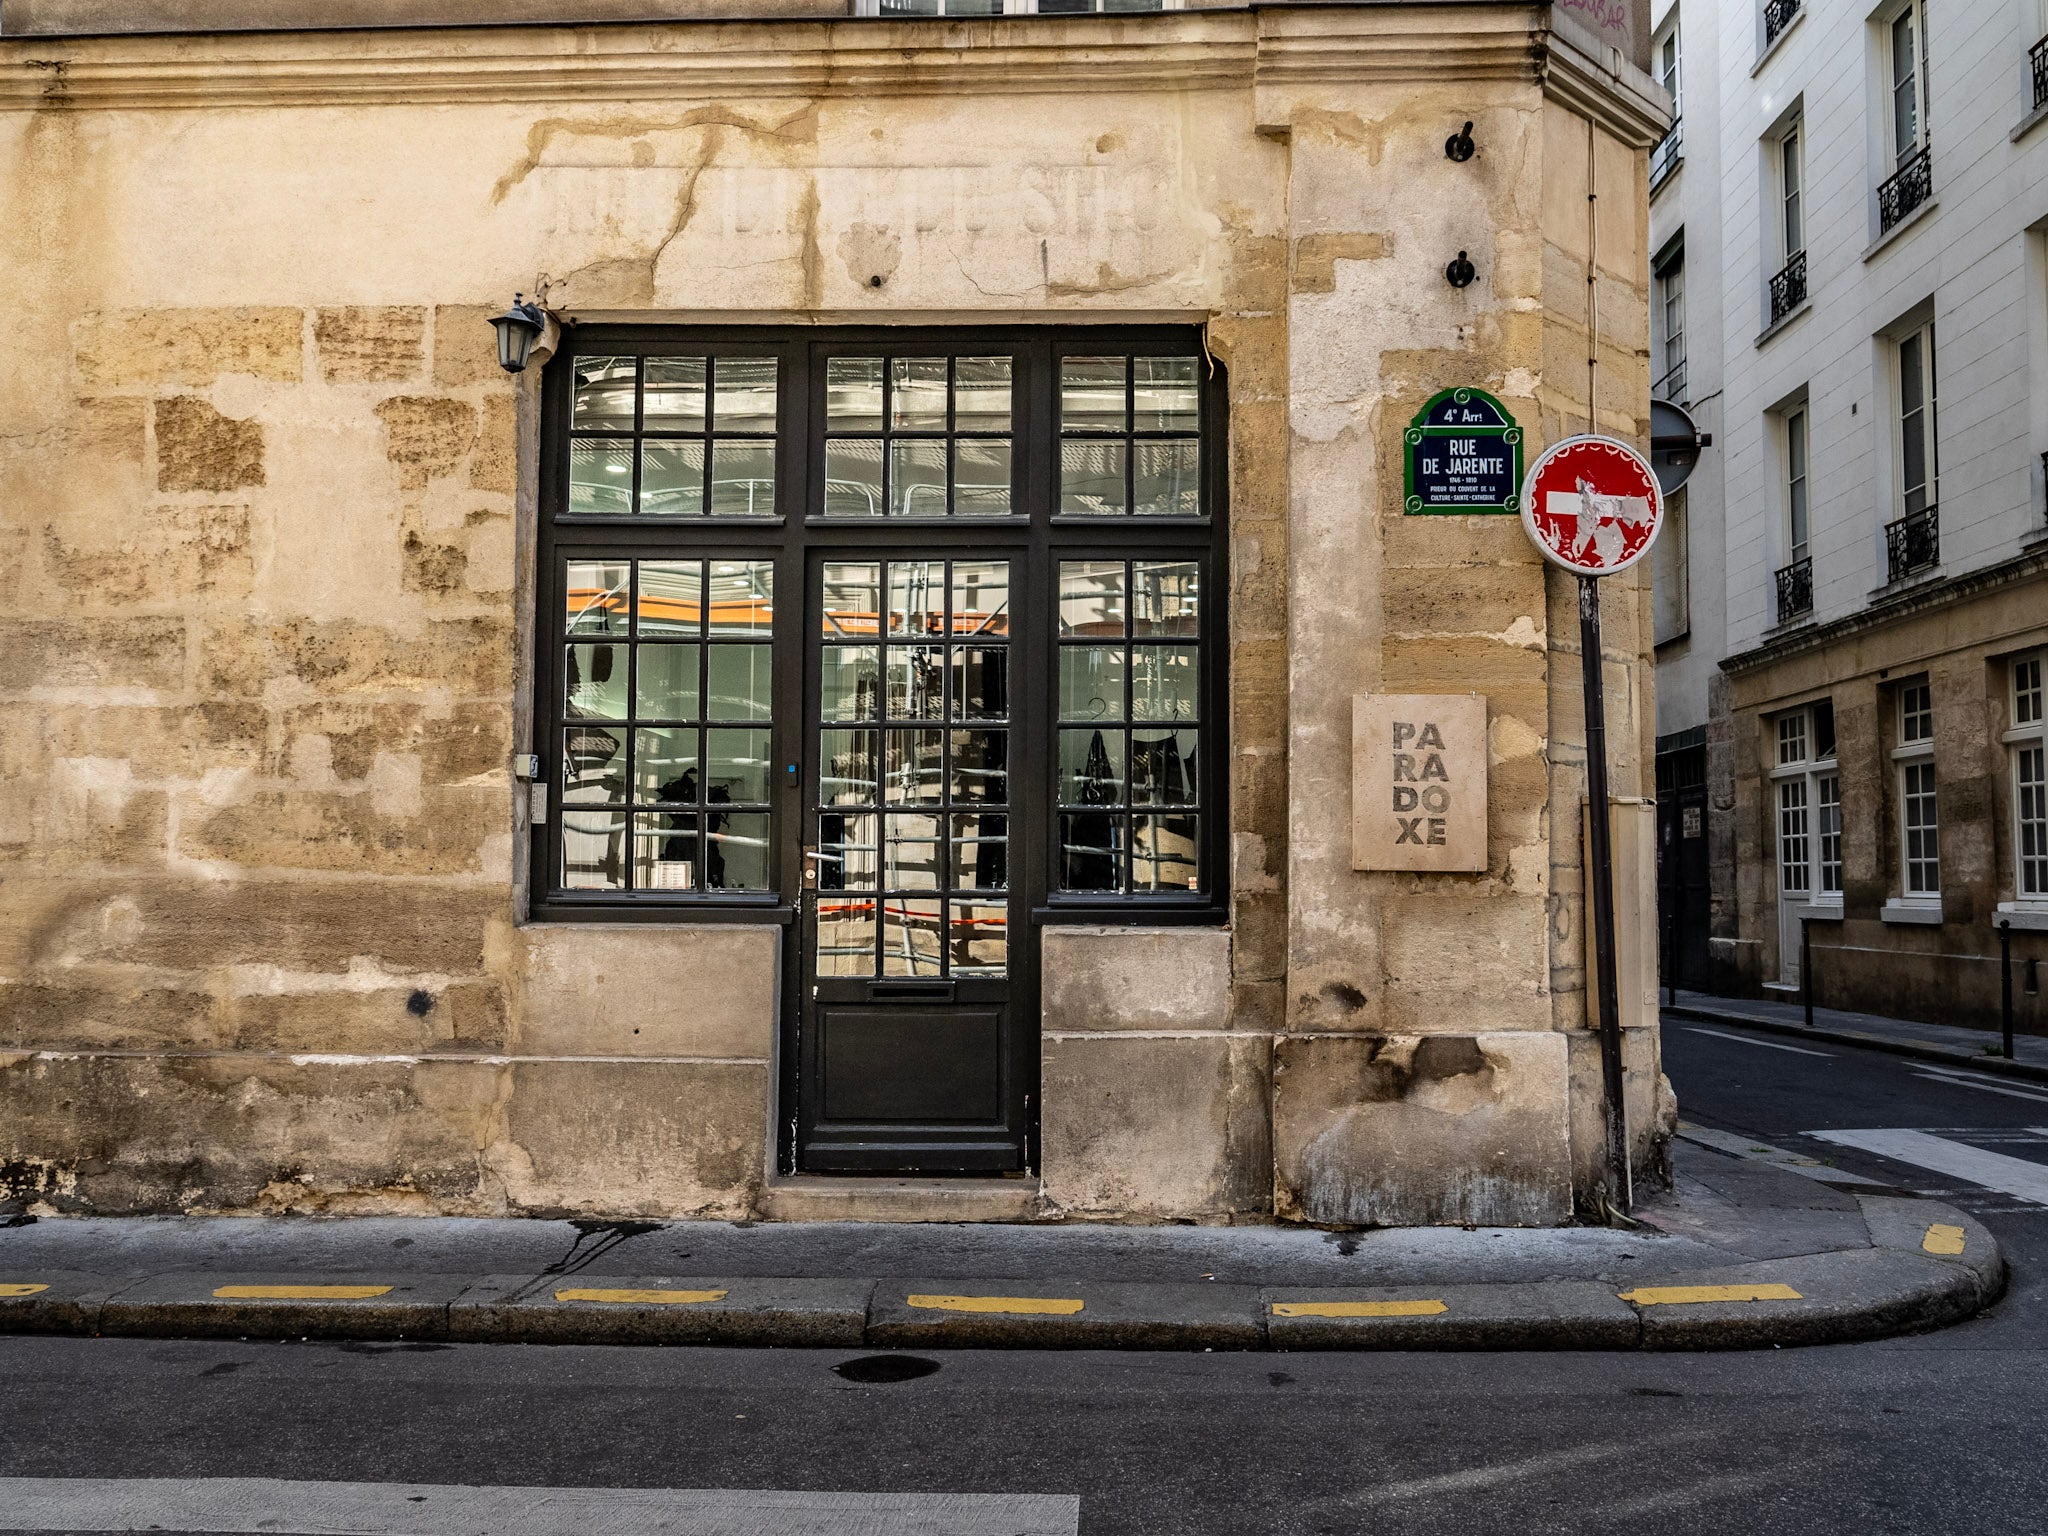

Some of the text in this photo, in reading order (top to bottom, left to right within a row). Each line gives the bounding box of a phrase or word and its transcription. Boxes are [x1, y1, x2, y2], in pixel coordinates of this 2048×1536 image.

[1450, 440, 1476, 455] RUE
[1423, 458, 1504, 474] DE JARENTE
[1392, 721, 1446, 750] PA
[1393, 753, 1450, 782] RA
[1392, 785, 1451, 813] DO
[1395, 817, 1447, 846] XE
